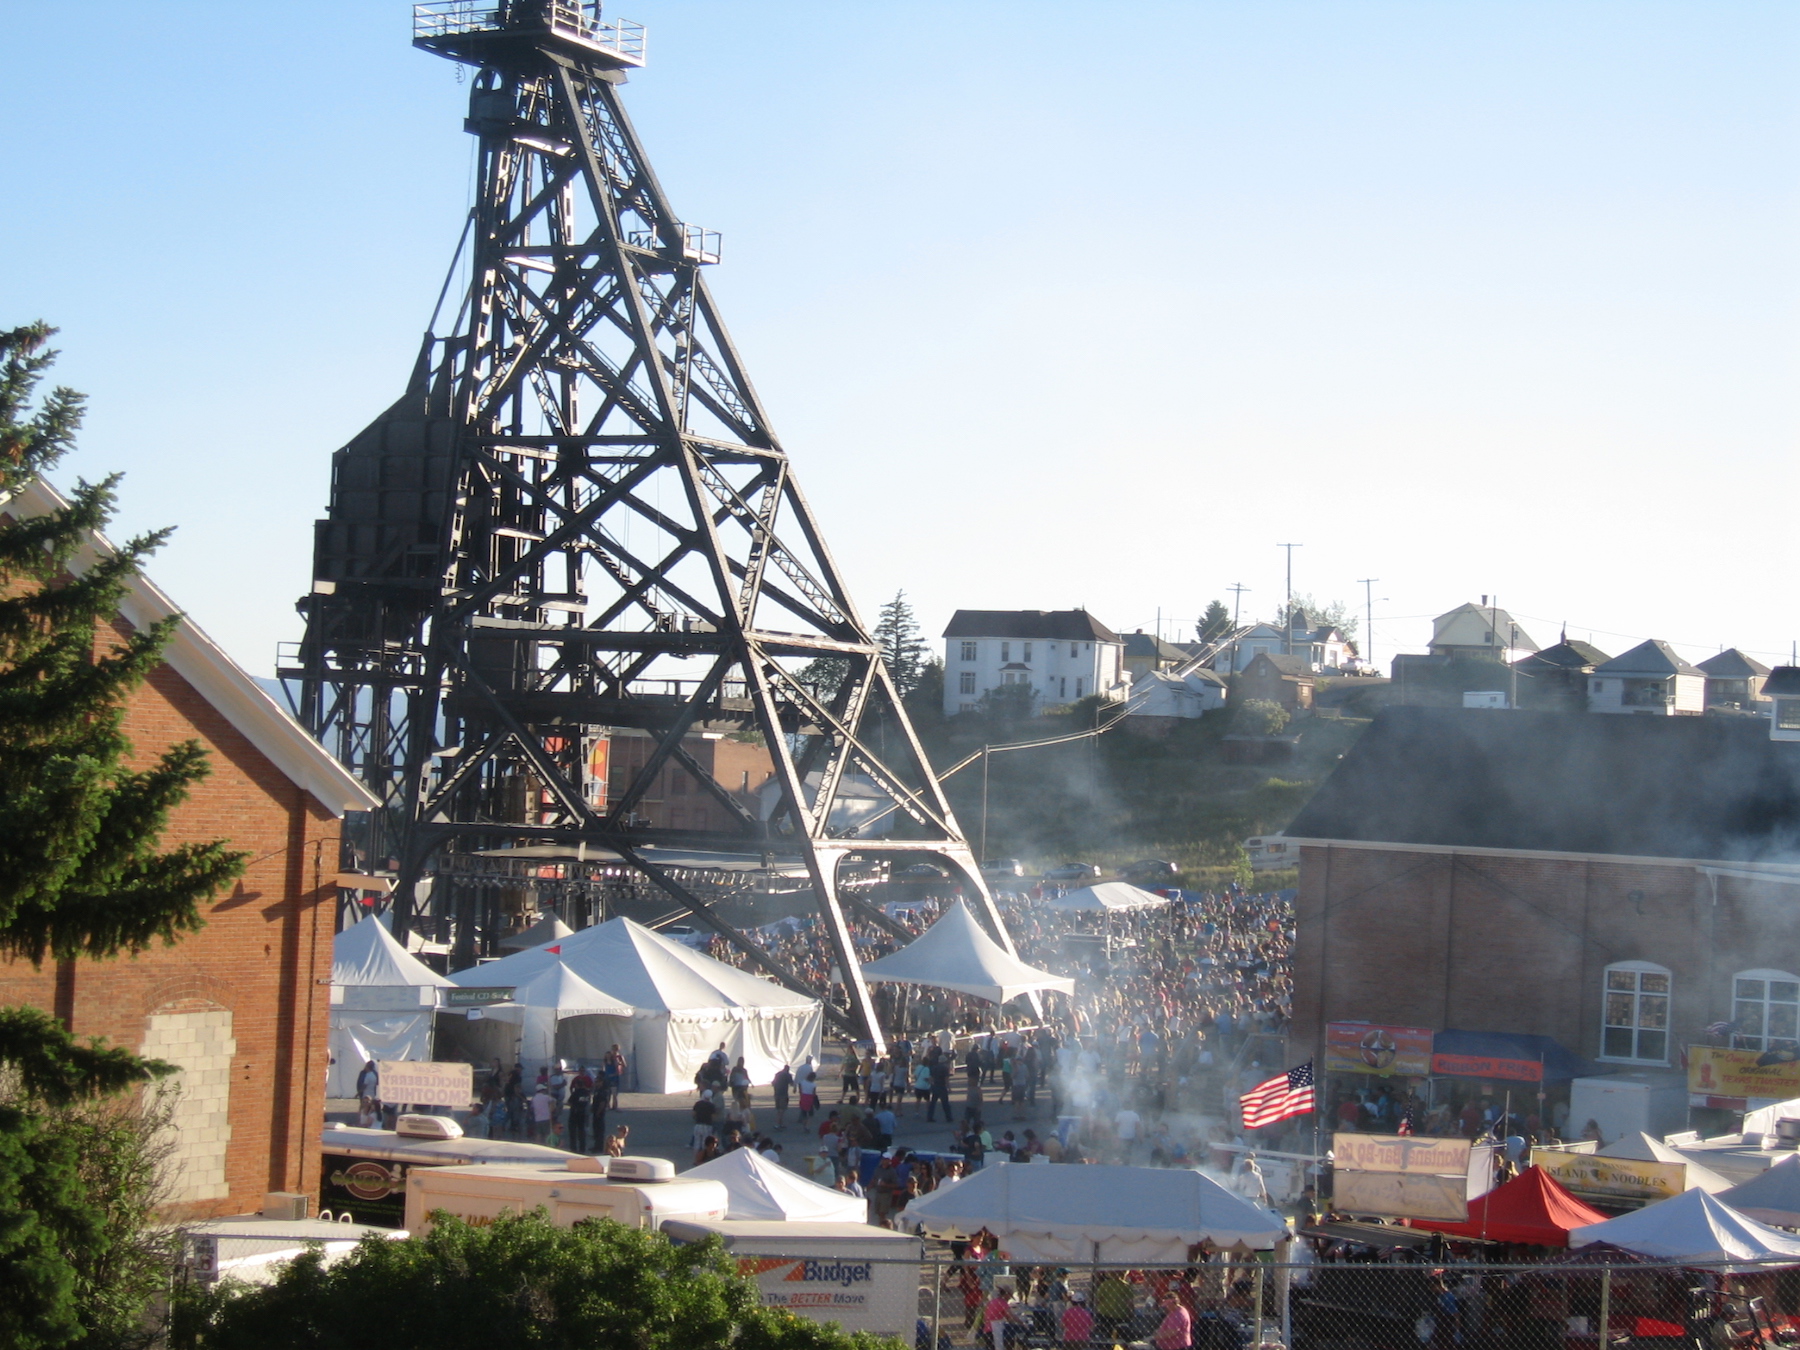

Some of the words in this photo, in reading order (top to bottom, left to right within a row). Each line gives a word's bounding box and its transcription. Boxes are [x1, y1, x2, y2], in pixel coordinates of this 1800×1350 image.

[1438, 1058, 1491, 1073] RIBBON
[1738, 1066, 1783, 1076] ORIGINAL
[1722, 1074, 1752, 1084] TEXAS
[1755, 1076, 1799, 1087] TWISTER
[1546, 1166, 1588, 1179] ISLAND
[1611, 1173, 1668, 1186] NOODLES
[803, 1260, 872, 1287] Budget
[768, 1293, 787, 1304] The
[791, 1292, 832, 1304] BETTER
[833, 1293, 864, 1304] Move
